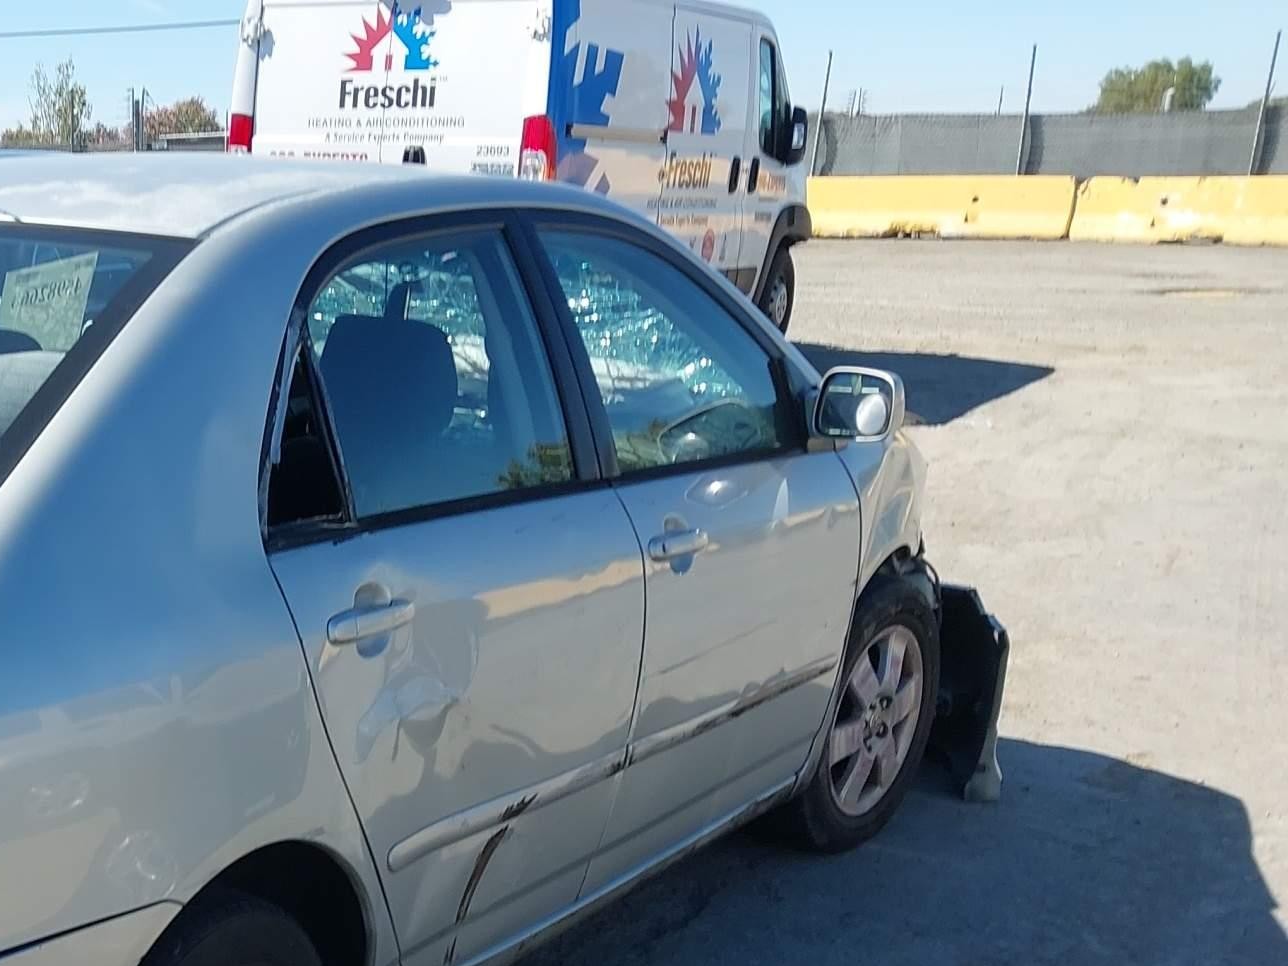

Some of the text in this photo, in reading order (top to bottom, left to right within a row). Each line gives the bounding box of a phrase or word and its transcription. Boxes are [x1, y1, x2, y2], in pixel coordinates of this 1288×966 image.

[339, 77, 437, 109] Freschi
[307, 116, 352, 129] HEATING
[366, 116, 383, 129] AIR
[385, 116, 465, 129] CONDITIONING
[334, 132, 365, 144] Service
[367, 132, 400, 147] Experts
[403, 132, 445, 146] Company
[666, 151, 714, 189] Freschi
